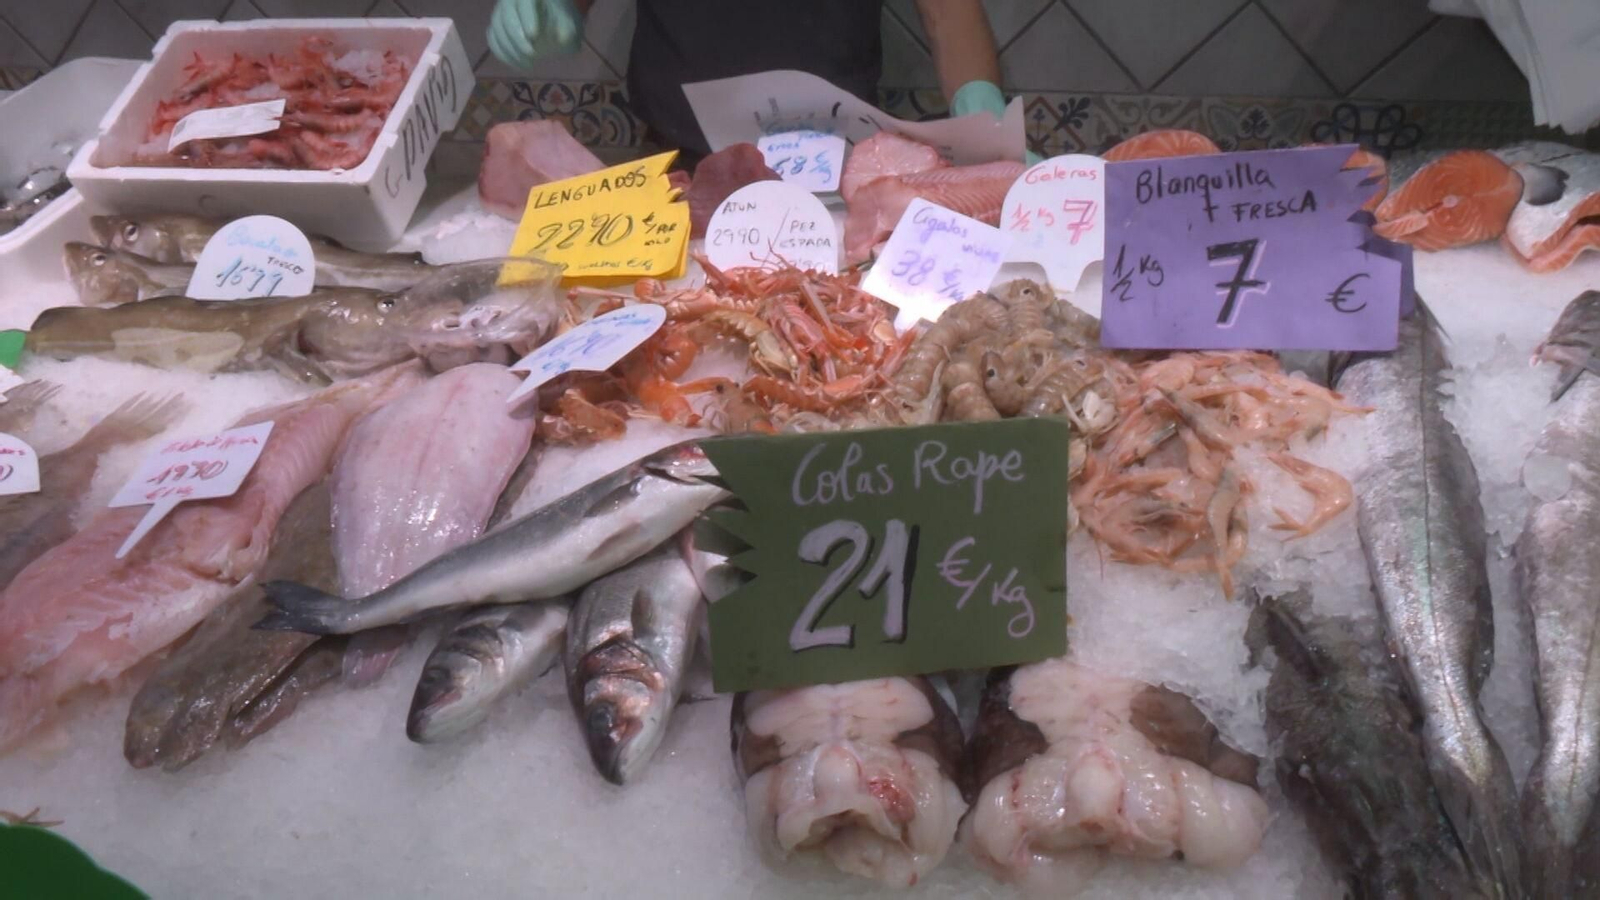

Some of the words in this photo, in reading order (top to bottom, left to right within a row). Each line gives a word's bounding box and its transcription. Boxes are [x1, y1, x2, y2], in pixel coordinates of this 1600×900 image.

[533, 165, 647, 209] LENGUADOS
[1024, 164, 1098, 185] Galeras
[1136, 161, 1277, 225] Blanquilla
[1063, 199, 1098, 247] 7
[1231, 190, 1317, 223] FRESCA
[891, 250, 936, 287] 38
[1206, 236, 1271, 330] 7
[1323, 271, 1371, 314] €
[789, 440, 895, 507] Colas
[912, 440, 1026, 516] Rape
[788, 518, 921, 654] 21
